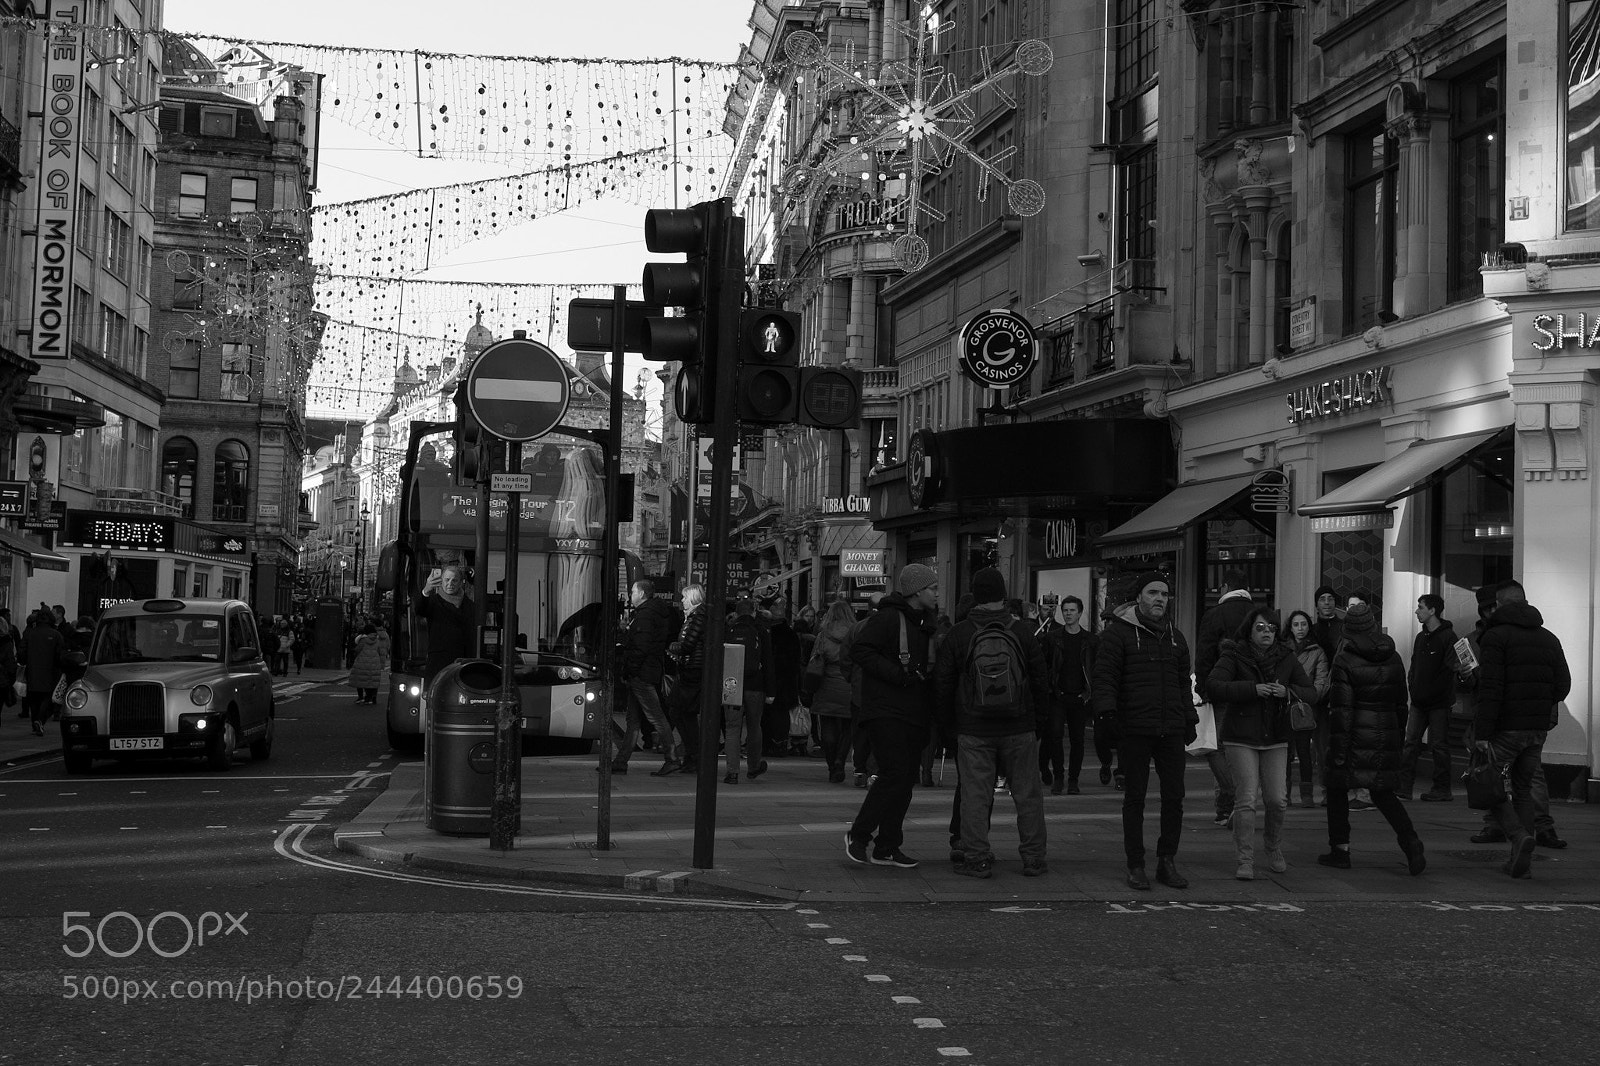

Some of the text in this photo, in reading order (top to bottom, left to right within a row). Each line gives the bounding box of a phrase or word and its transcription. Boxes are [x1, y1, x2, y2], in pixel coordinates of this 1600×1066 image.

[38, 5, 78, 353] THE BOOK OF MORMON
[970, 318, 1029, 348] GROSVENOR
[1292, 323, 1305, 336] STREET
[975, 360, 1024, 379] CASINOS
[1286, 366, 1386, 424] SHAKE SHACK
[505, 476, 529, 484] loading
[0, 503, 9, 512] 24
[451, 495, 473, 506] The
[519, 498, 548, 509] Tour
[846, 494, 871, 513] GUM
[555, 499, 576, 521] T2
[555, 538, 573, 547] YXY
[1045, 517, 1077, 559] CASINO
[846, 552, 879, 561] MONEY
[844, 563, 881, 572] CHANGE
[113, 738, 160, 749] LT57 STZ
